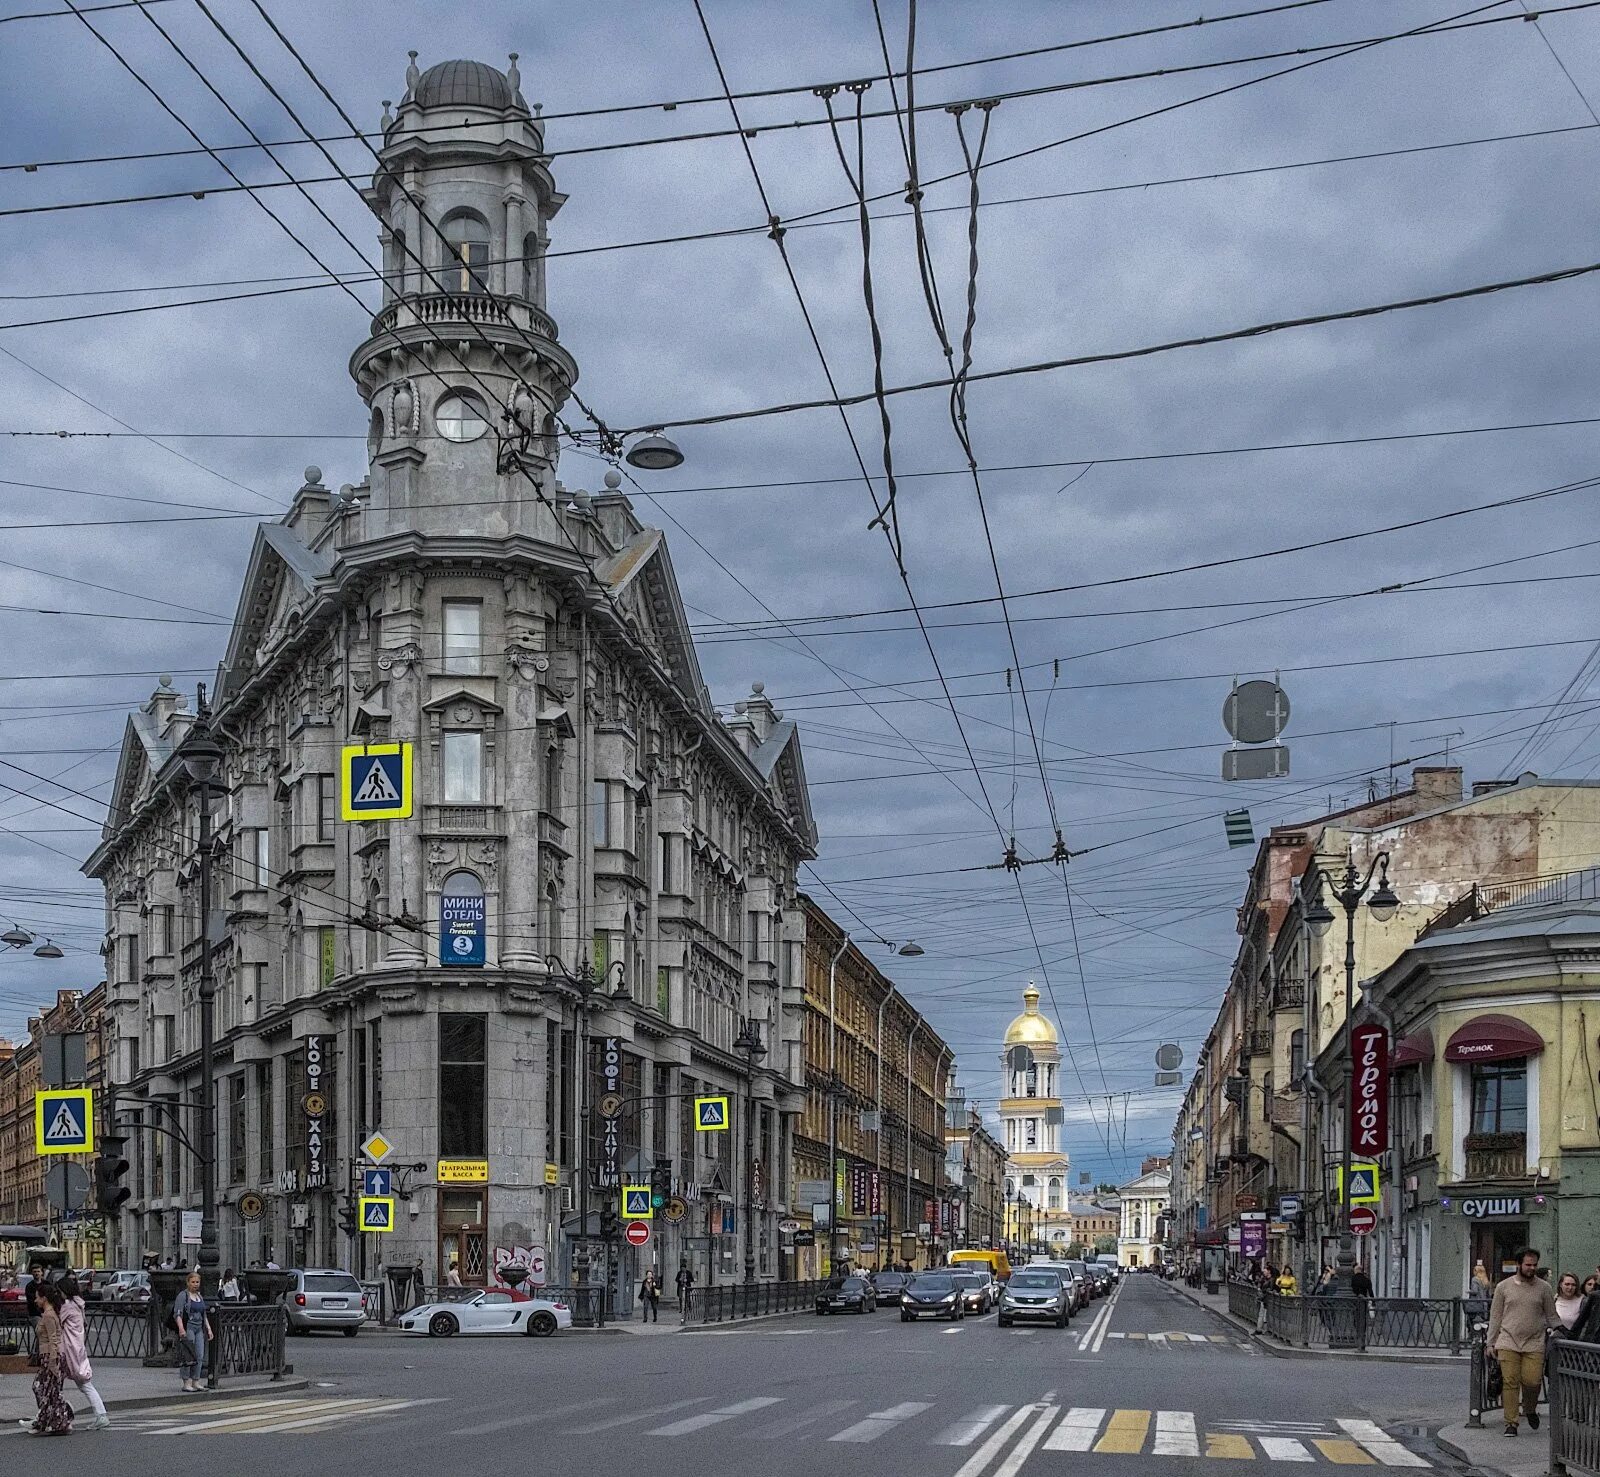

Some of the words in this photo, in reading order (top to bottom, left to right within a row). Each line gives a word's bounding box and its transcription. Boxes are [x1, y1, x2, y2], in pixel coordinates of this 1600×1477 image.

[443, 909, 483, 920] ОТЕЛЬ
[444, 898, 483, 908] МИНИ
[459, 938, 467, 948] 3
[307, 1036, 322, 1090] КОФЕ
[604, 1038, 619, 1091] КОФЕ
[1457, 1044, 1494, 1055] Теремок
[1357, 1033, 1382, 1145] Теремок
[308, 1120, 322, 1173] ХАУЗ
[604, 1120, 618, 1173] ХАУЗ
[277, 1169, 297, 1191] КОФЕ
